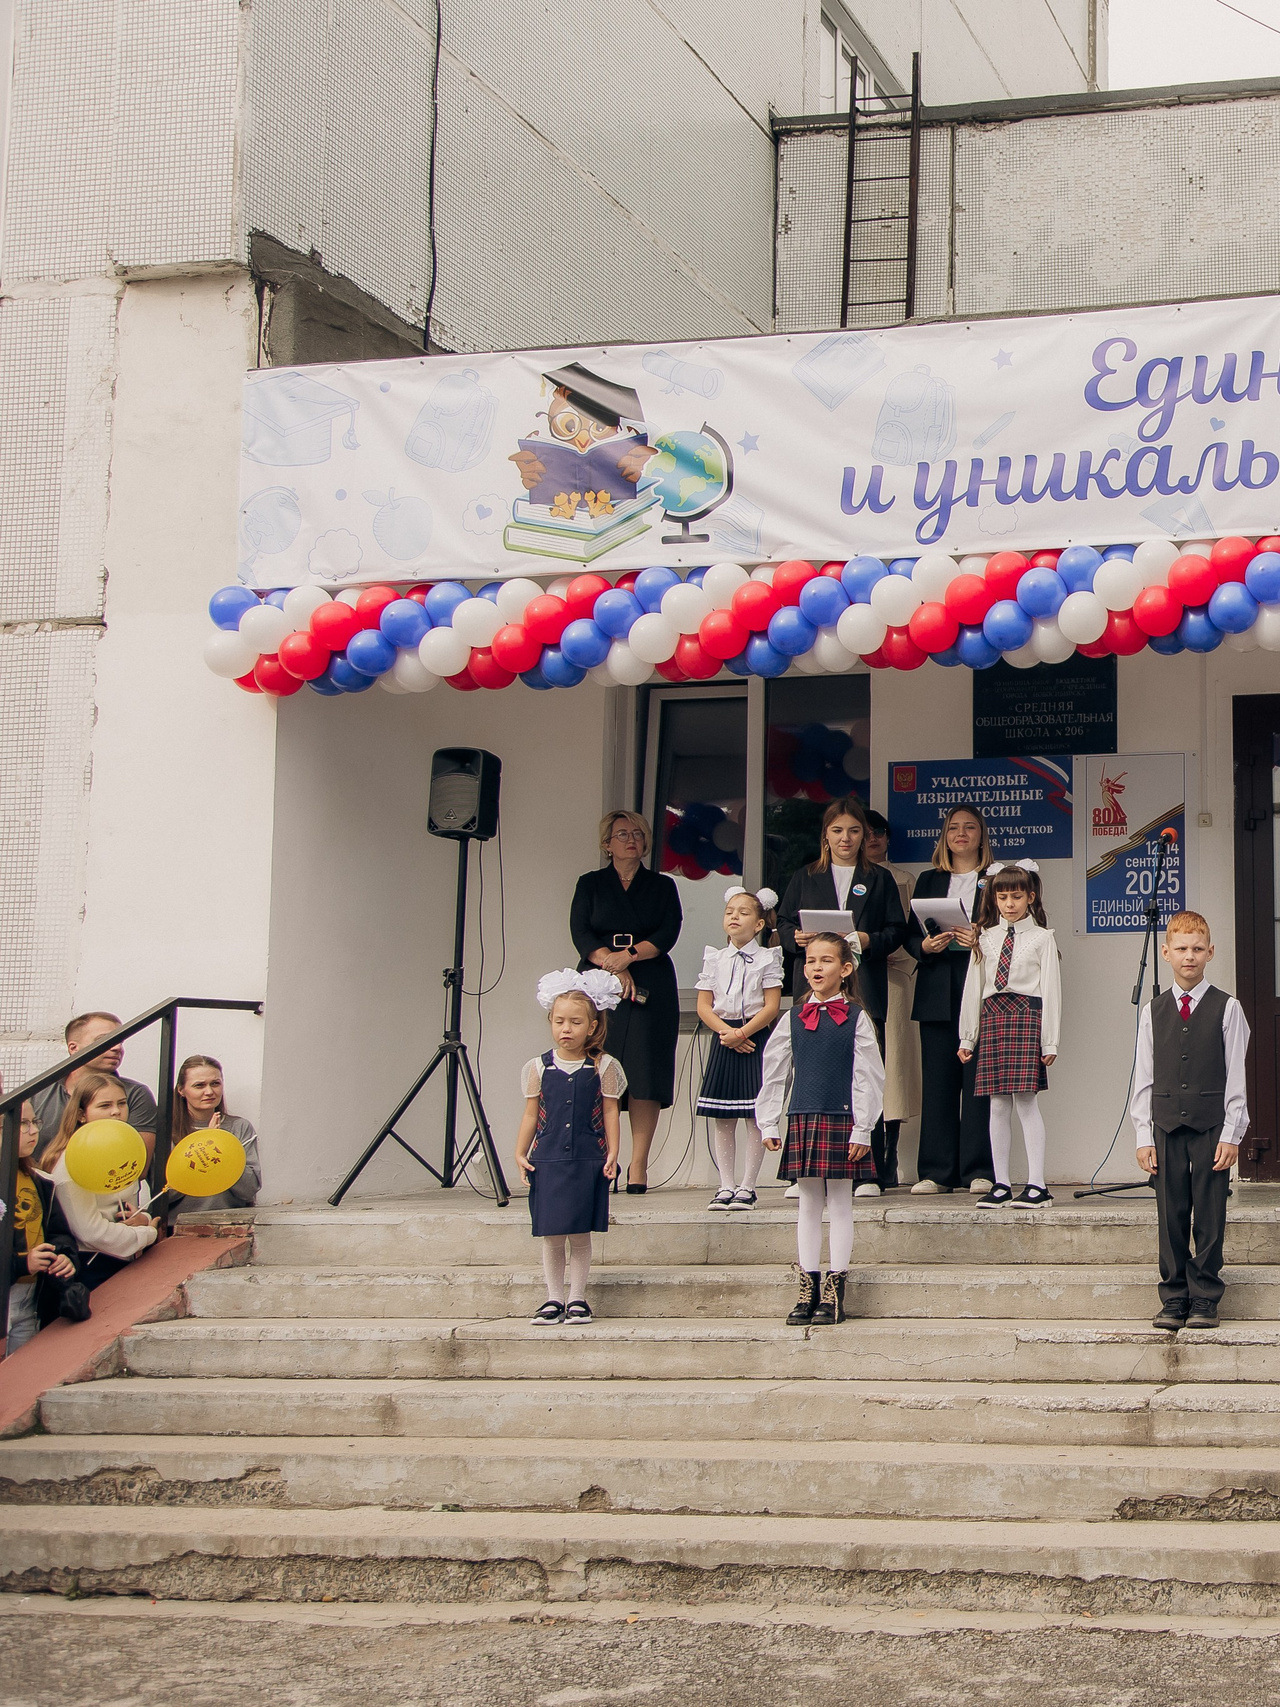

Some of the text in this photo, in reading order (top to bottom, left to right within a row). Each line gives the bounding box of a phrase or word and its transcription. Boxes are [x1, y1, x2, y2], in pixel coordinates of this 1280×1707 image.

[840, 465, 896, 515] и
[975, 712, 1114, 727] ОБЩЕОБРАЗОВАТЕЛЬНАЯ
[1005, 728, 1050, 739] ШКОЛА
[931, 774, 1028, 788] УЧАСТКОВЫЕ
[917, 789, 1044, 804] ИЗБИРАТЕЛЬНЫЕ
[938, 805, 1022, 819] КССИИ
[1092, 807, 1111, 824] 80
[1000, 825, 1054, 836] УЧАСТКОВ
[1092, 827, 1128, 837] ПОБЕДА!
[1003, 838, 1025, 847] 1829
[1125, 870, 1180, 895] 2025
[1092, 896, 1180, 914] ЕДИНЫЙ ЕНЬ
